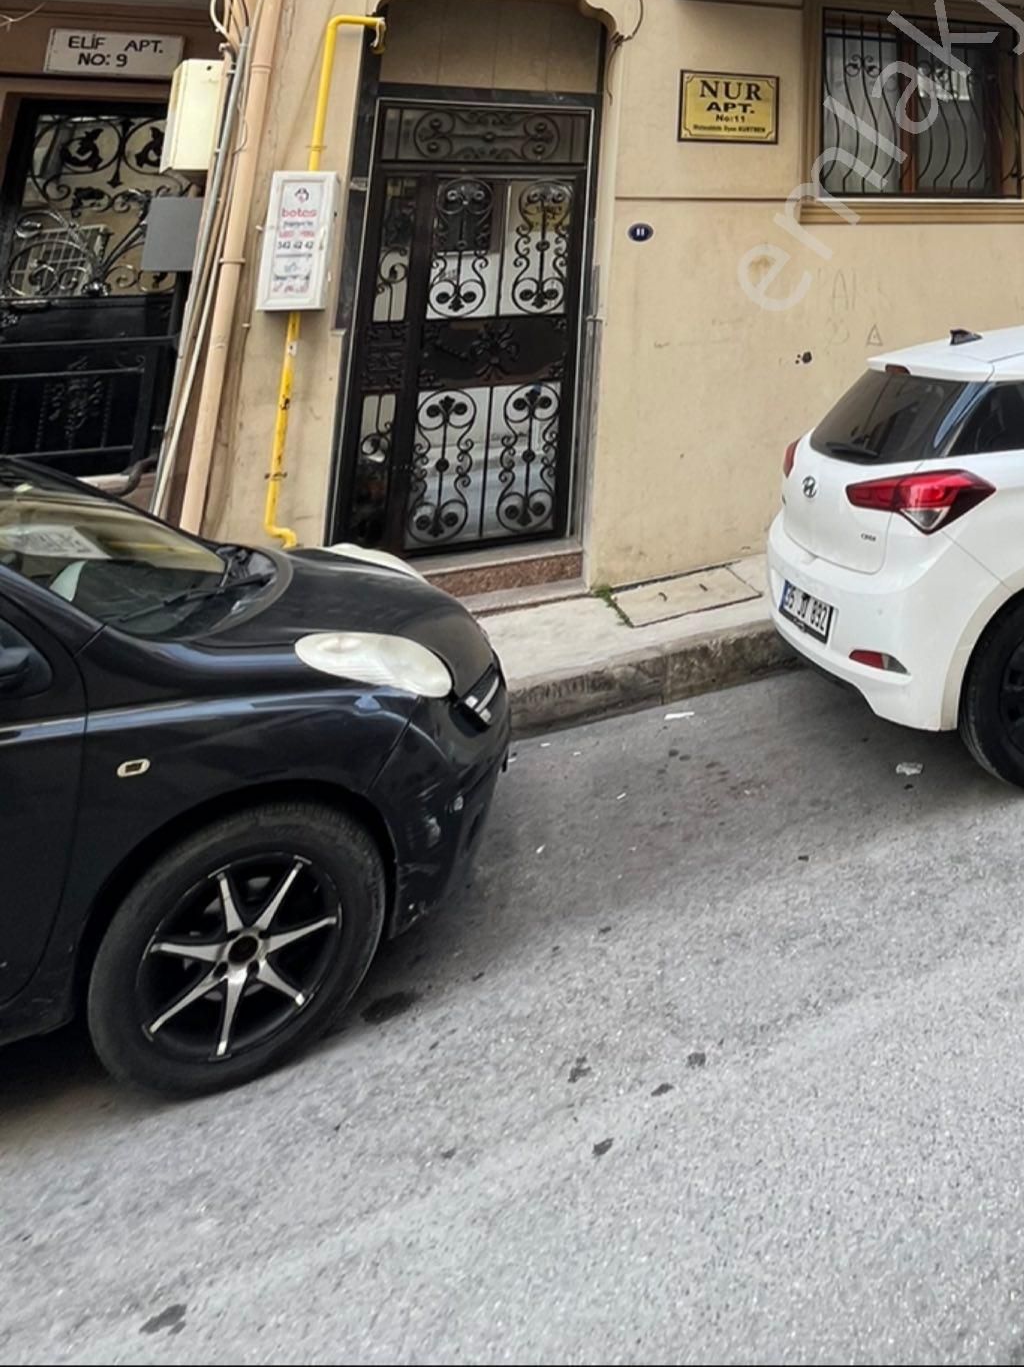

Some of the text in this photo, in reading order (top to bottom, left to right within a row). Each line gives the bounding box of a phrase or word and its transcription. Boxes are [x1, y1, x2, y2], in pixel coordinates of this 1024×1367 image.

[68, 34, 163, 53] ELİF APT.
[116, 54, 128, 67] 9
[699, 80, 762, 101] NUR
[706, 101, 755, 114] APT.
[277, 241, 291, 249] 342
[811, 600, 828, 631] 892
